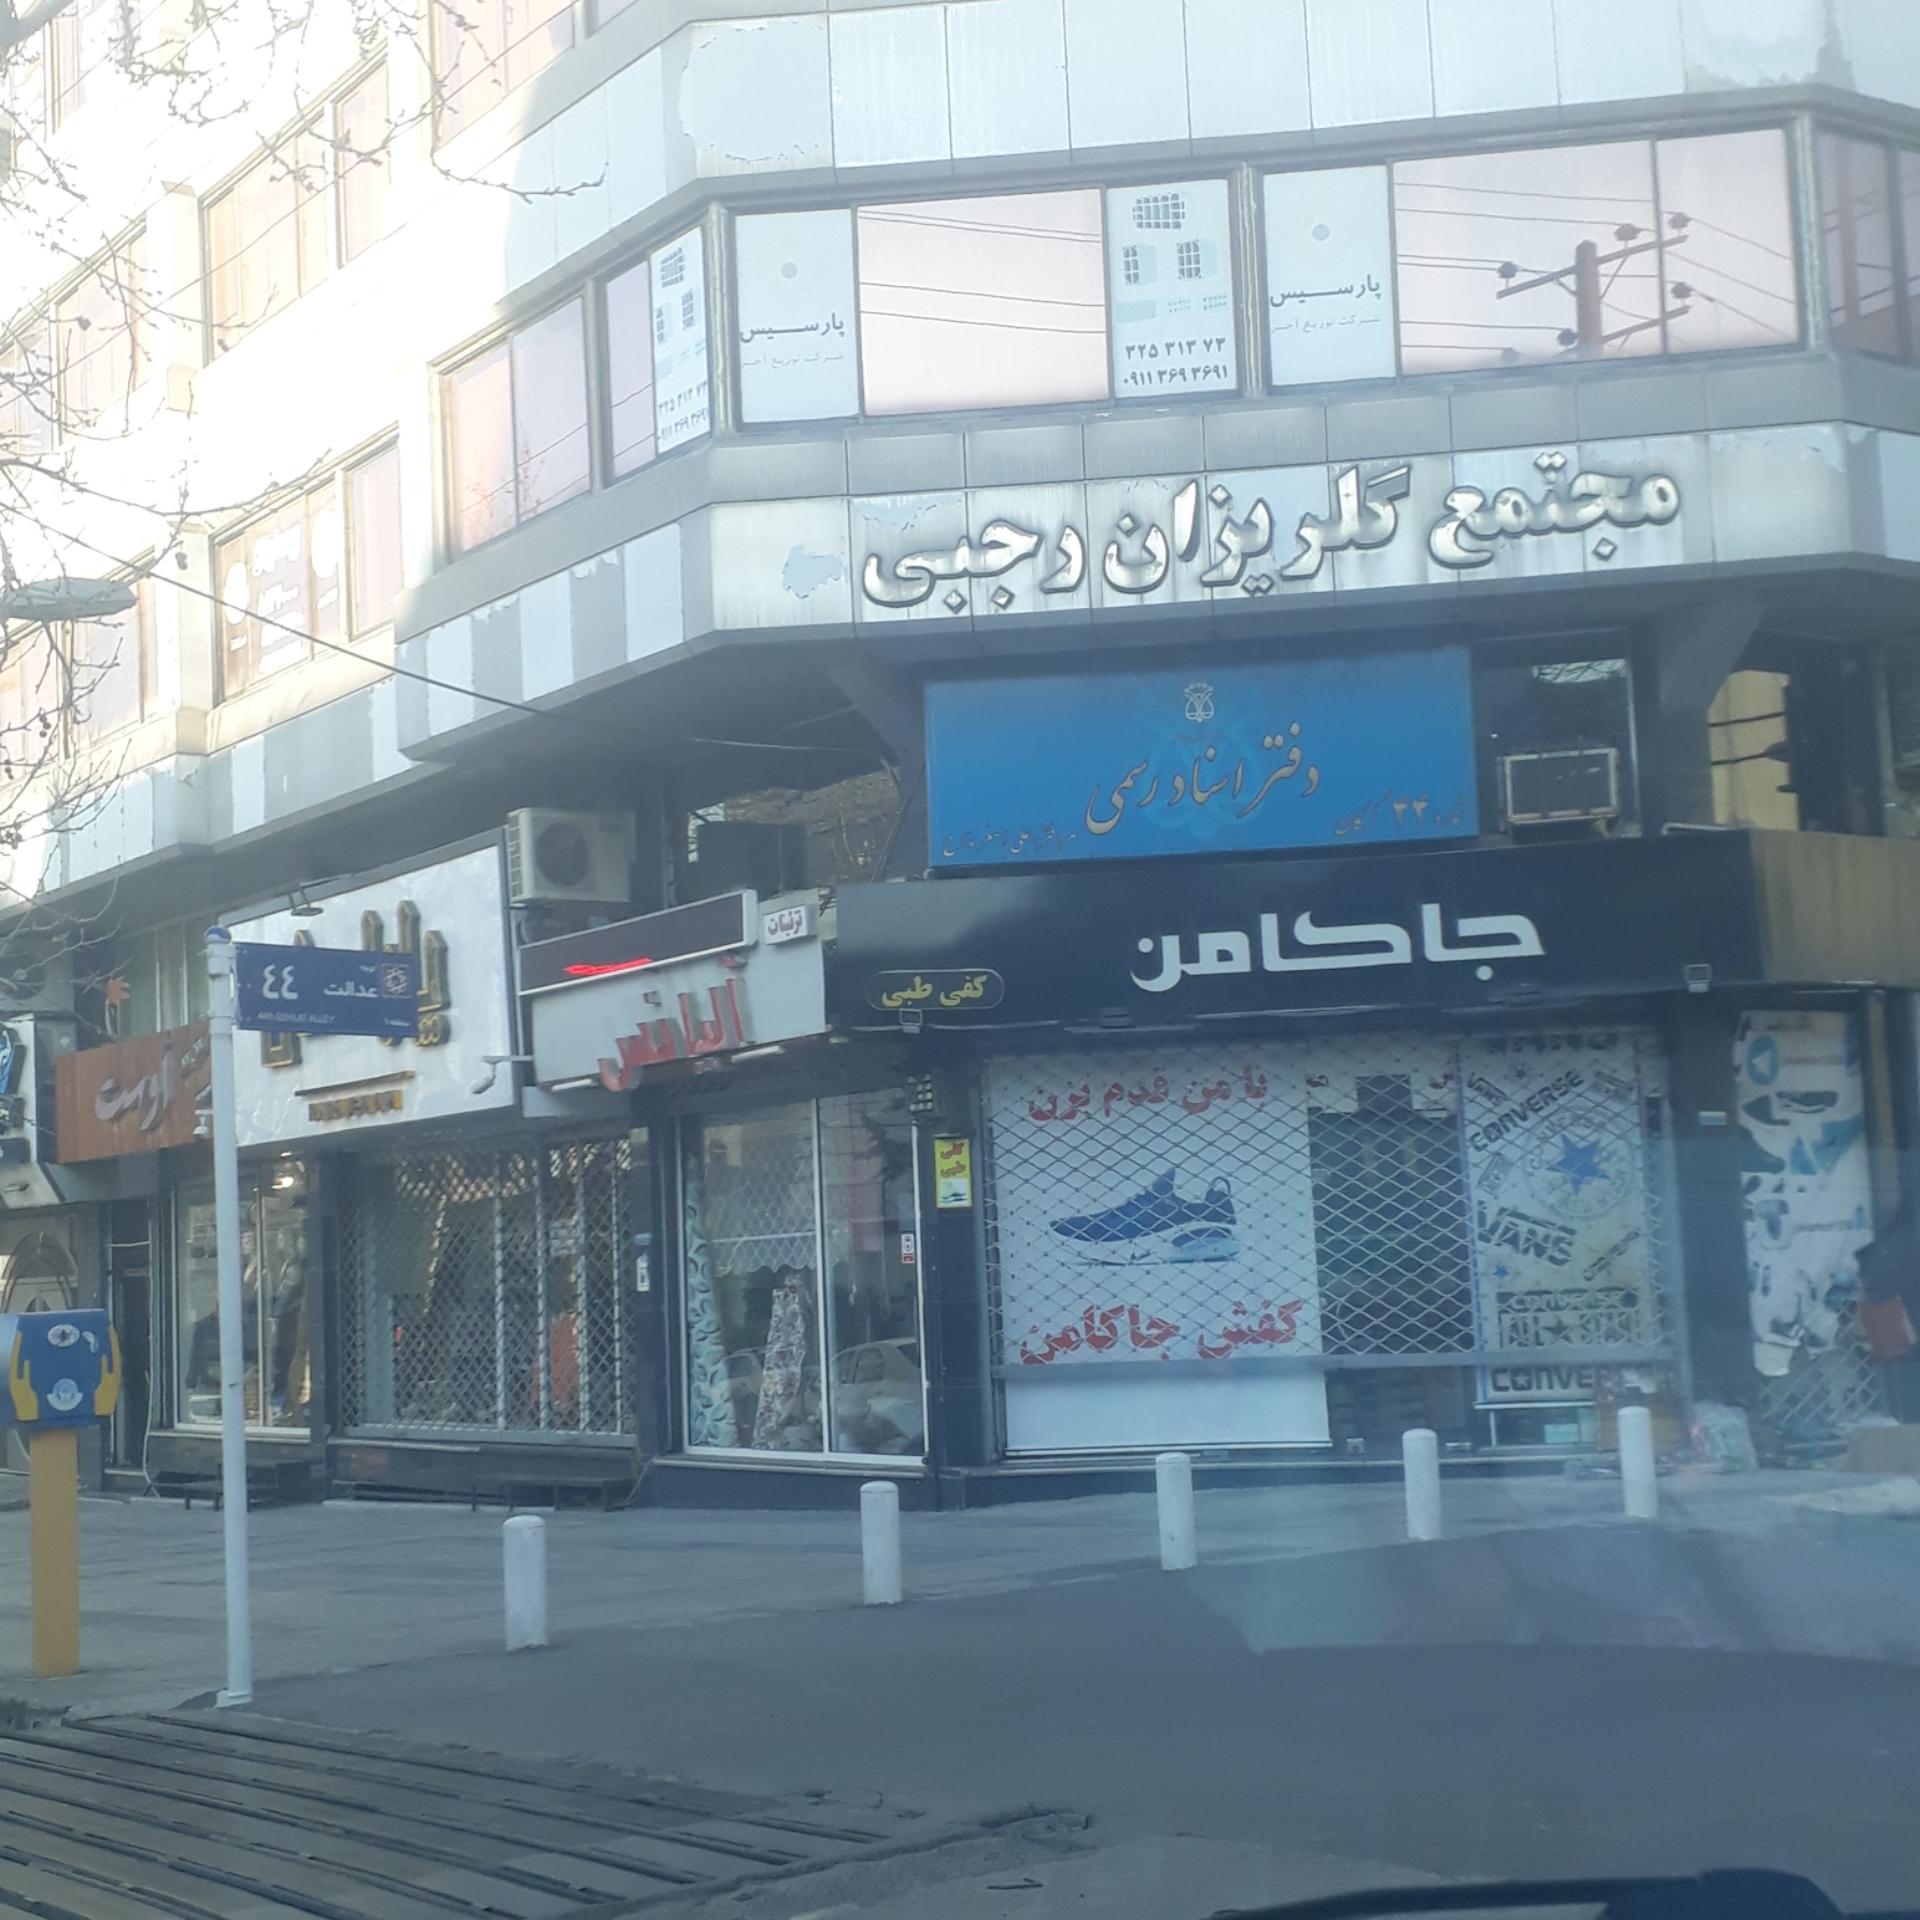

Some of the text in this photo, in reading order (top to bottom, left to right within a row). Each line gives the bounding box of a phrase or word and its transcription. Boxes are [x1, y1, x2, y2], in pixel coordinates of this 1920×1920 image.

[1429, 450, 1681, 570] مجتمع
[862, 517, 1087, 614] رجبی
[1084, 720, 1321, 836] دفتر اسناد رسمی
[1129, 902, 1545, 993] جاکامن
[323, 979, 379, 999] عدالت
[882, 974, 988, 1007] کفی طبی
[1102, 1066, 1170, 1119] قدم
[1182, 1078, 1232, 1114] من
[1242, 1063, 1268, 1112] با
[1468, 1068, 1585, 1152] CONVERSE
[1477, 1200, 1577, 1267] VANS
[1197, 1296, 1305, 1360] کفش
